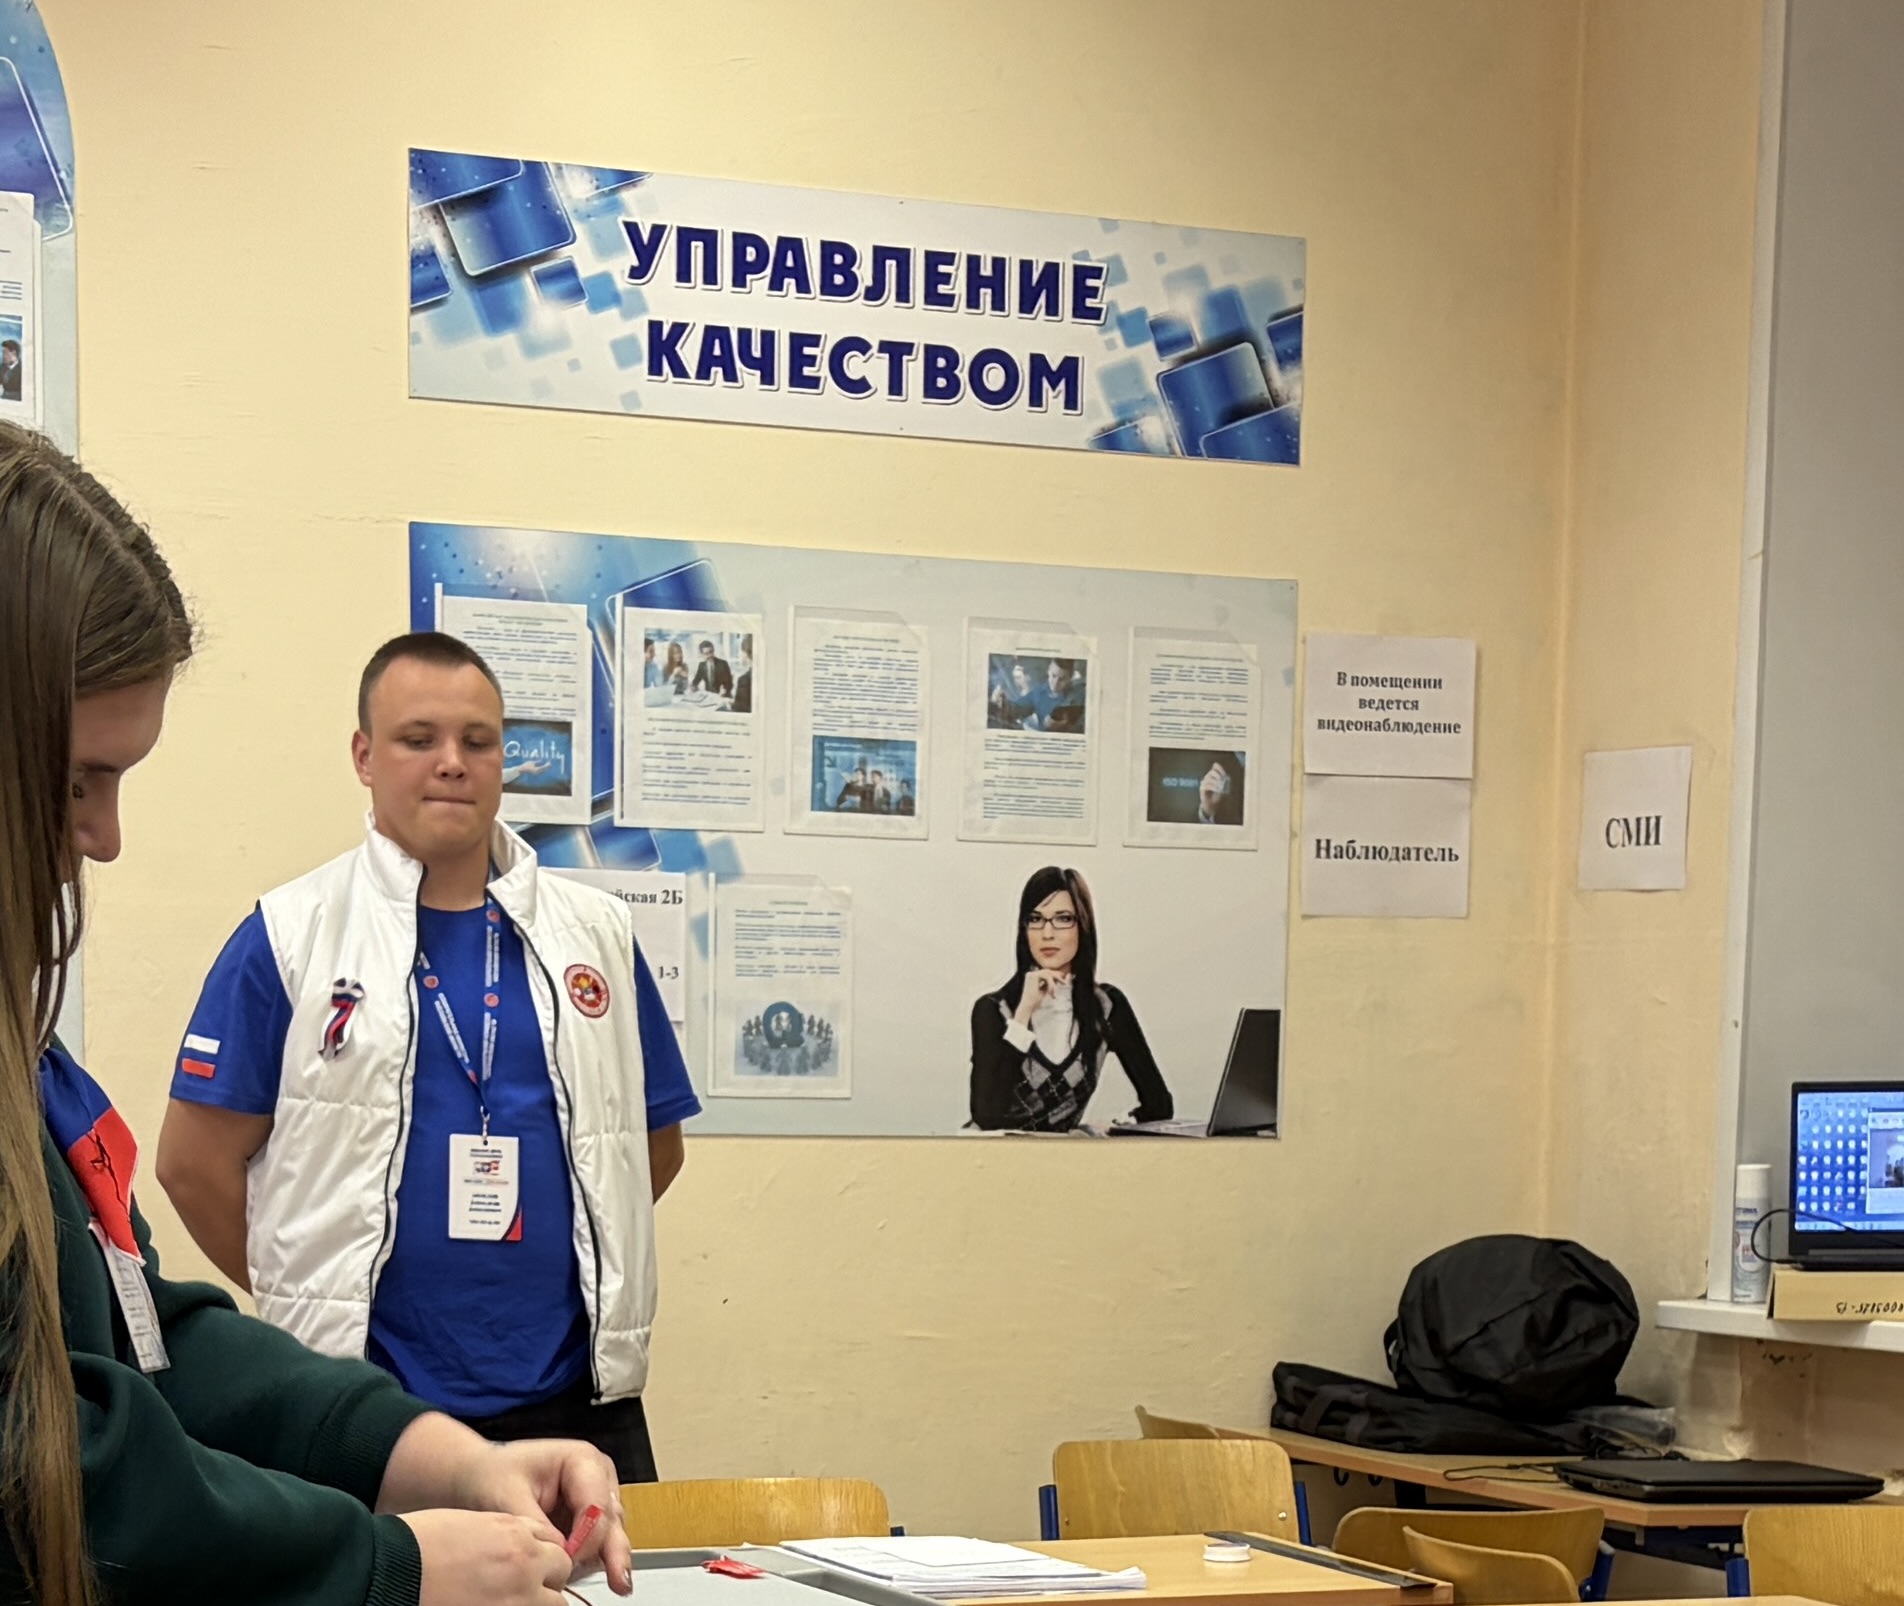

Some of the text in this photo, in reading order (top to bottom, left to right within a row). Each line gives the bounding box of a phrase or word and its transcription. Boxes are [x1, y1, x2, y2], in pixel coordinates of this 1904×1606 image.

[622, 217, 1110, 325] УПРАВЛЕНИЕ
[645, 317, 1084, 415] КАЧЕСТВОМ
[1337, 671, 1443, 691] В помещении
[1358, 695, 1420, 713] ведется
[1317, 716, 1462, 737] видеонаблюдение
[504, 740, 565, 775] Quality
[1605, 815, 1663, 849] СМИ
[1315, 838, 1460, 865] Наблюдатель
[609, 889, 684, 906] йская 2Б
[658, 965, 680, 980] 1-3
